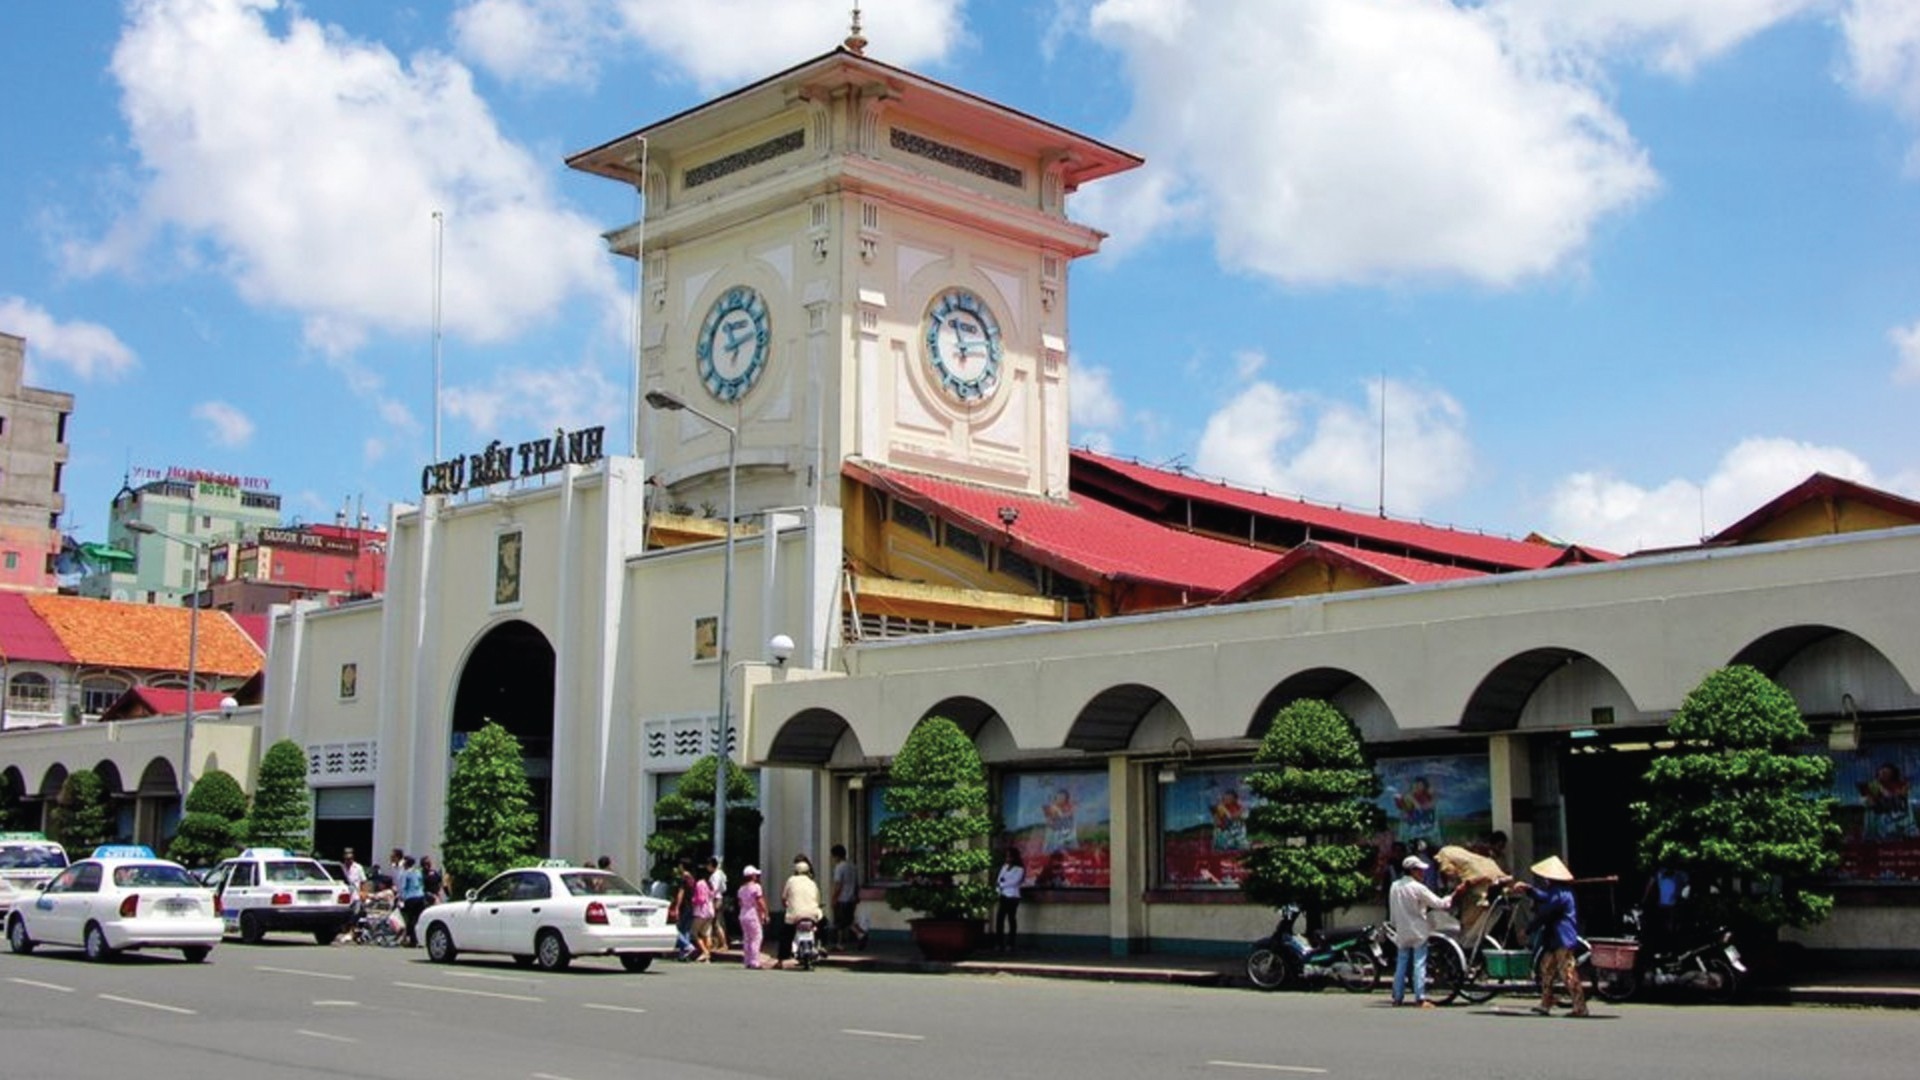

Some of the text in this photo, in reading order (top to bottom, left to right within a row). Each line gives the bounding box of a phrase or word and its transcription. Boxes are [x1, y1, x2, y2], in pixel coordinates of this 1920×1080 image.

[422, 454, 465, 495] CHỢ
[519, 426, 605, 477] THÀNH
[199, 483, 236, 498] HOTEL
[263, 529, 298, 544] SAIGON
